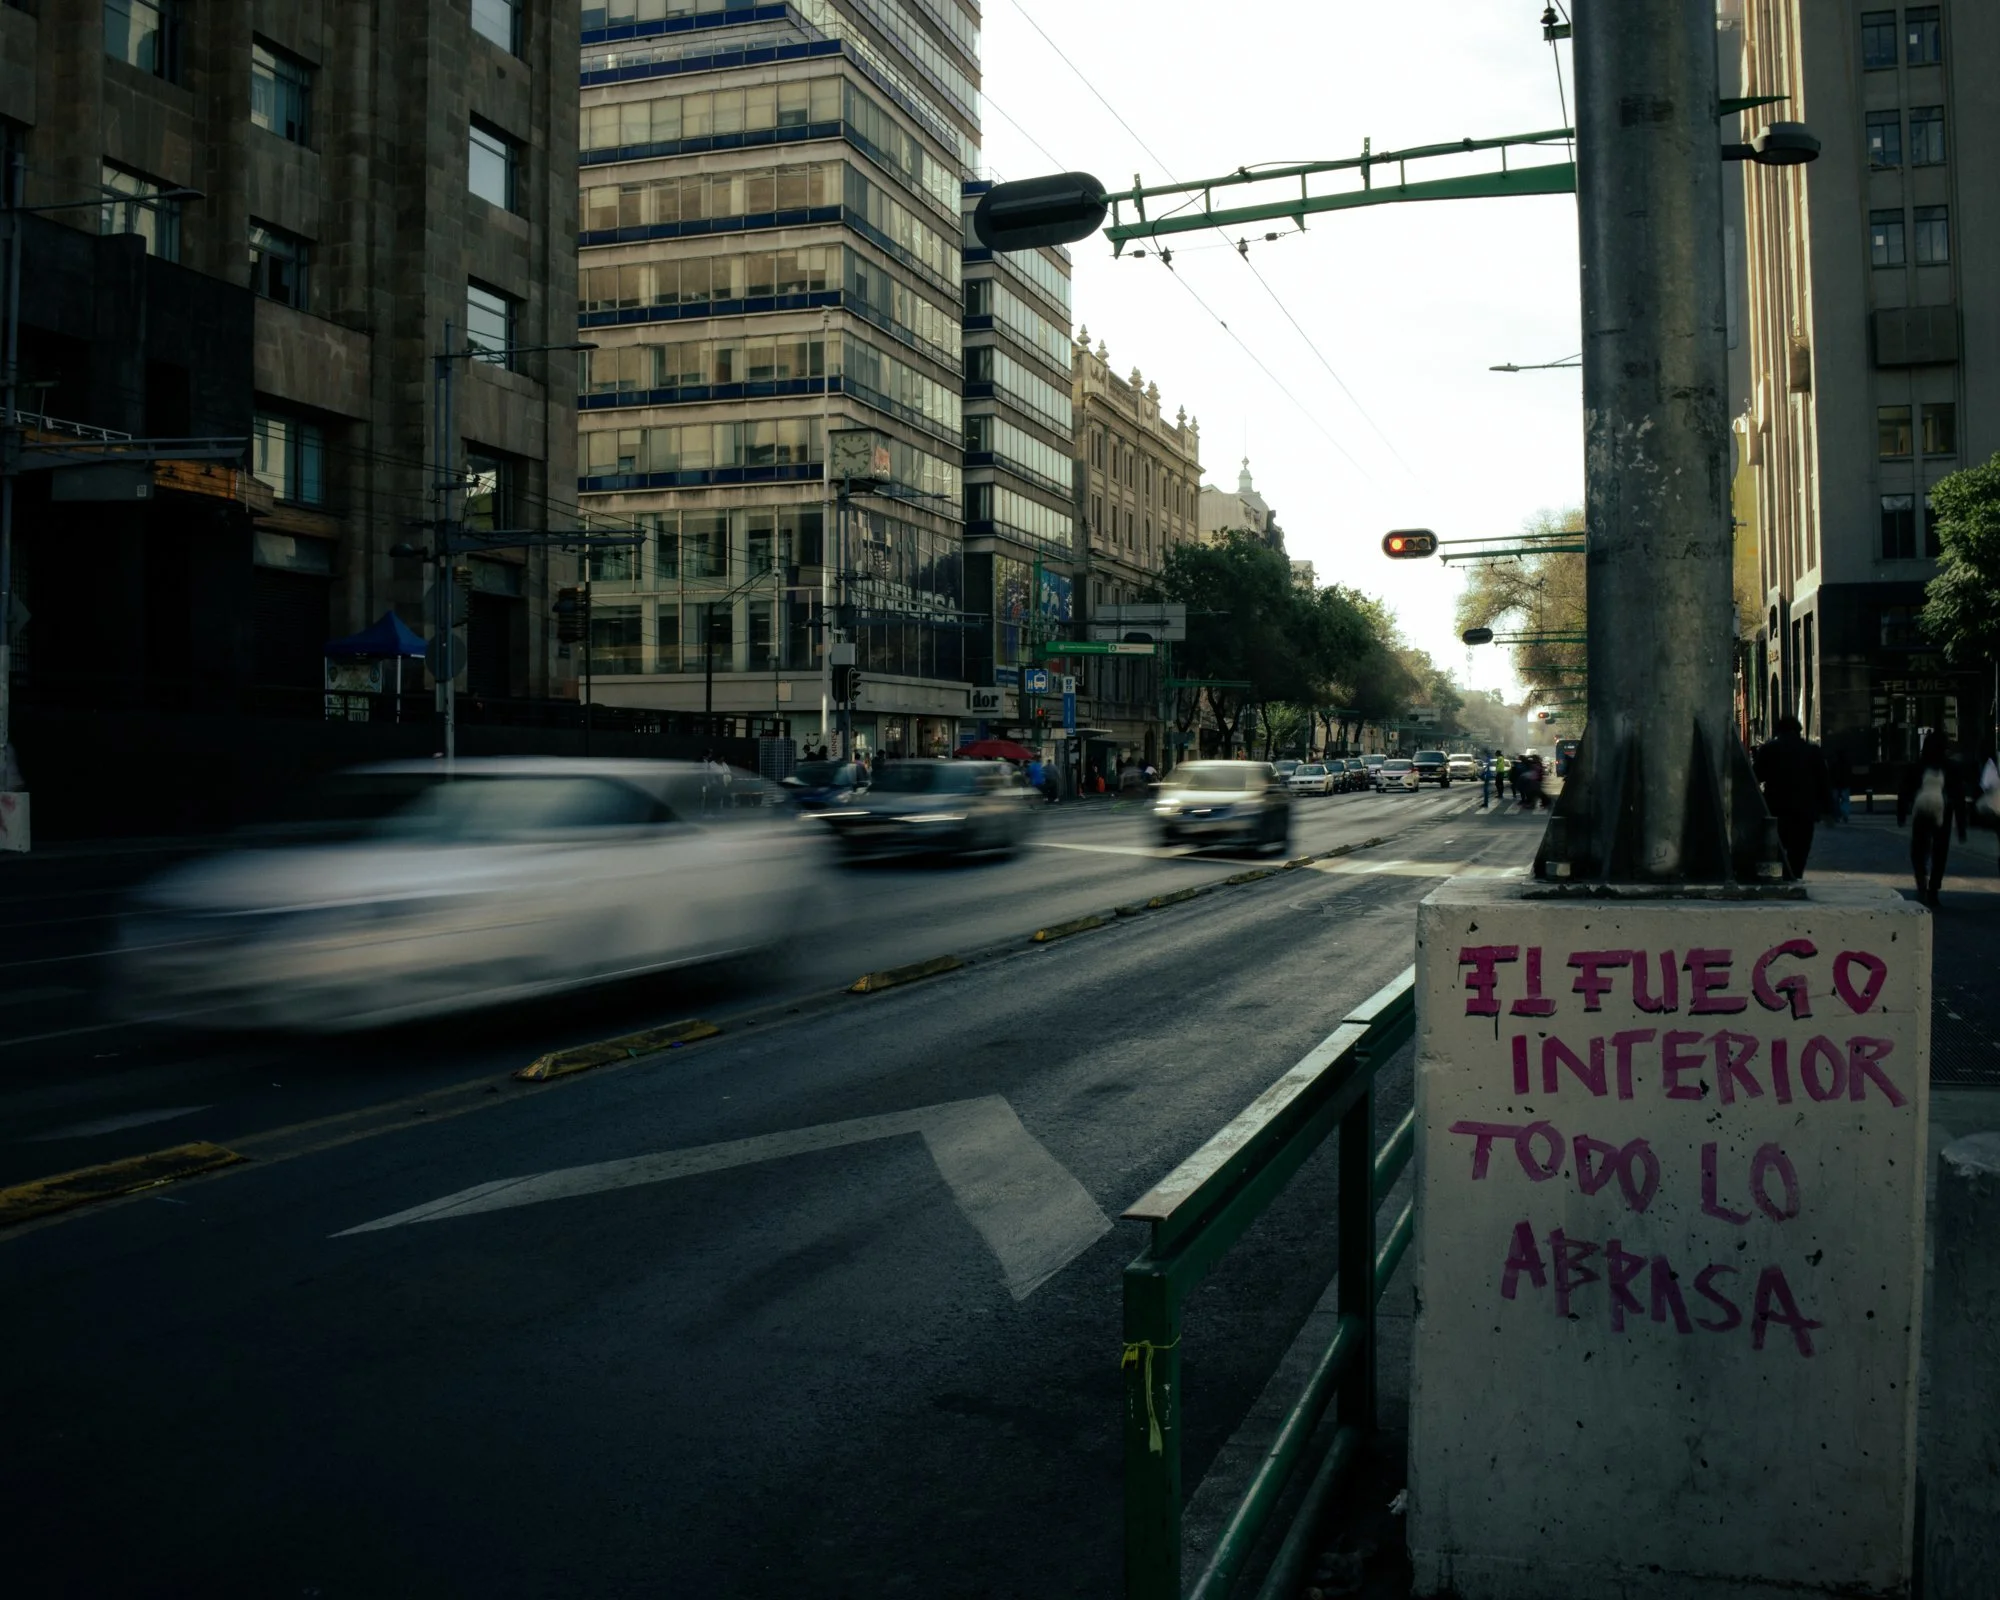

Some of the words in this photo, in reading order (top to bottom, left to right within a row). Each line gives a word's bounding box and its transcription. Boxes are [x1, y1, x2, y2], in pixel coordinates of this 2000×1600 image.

[1880, 679, 1960, 692] TELMEX
[1567, 939, 1887, 1020] FUEGO
[1511, 1028, 1908, 1107] INTERIOR
[1448, 1120, 1660, 1214] TODO
[1700, 1142, 1800, 1225] LO
[1501, 1220, 1823, 1358] ABRASA
